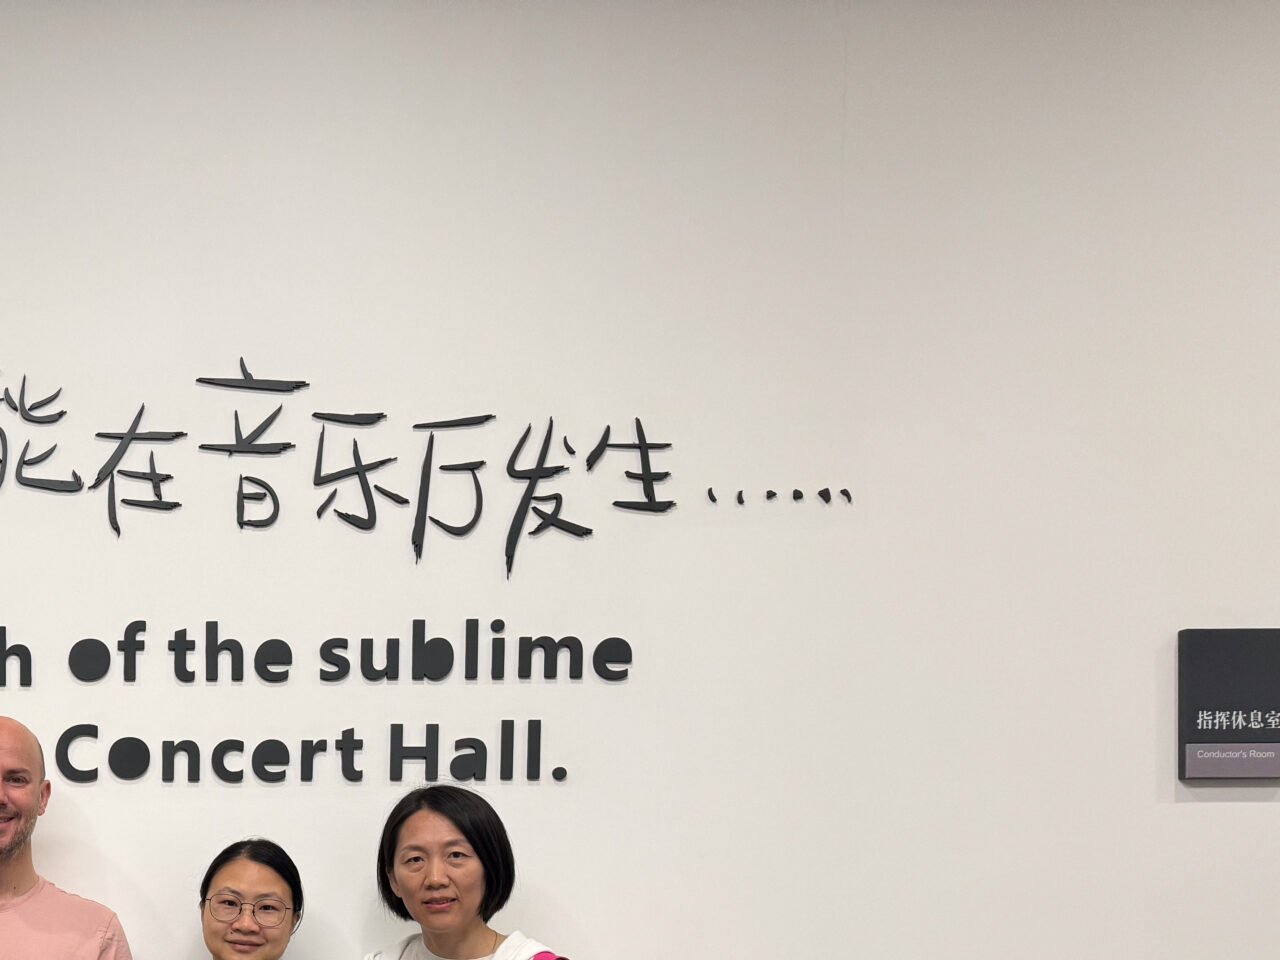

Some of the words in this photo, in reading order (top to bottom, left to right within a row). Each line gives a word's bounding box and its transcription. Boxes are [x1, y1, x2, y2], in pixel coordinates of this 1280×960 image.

[68, 620, 147, 684] of
[167, 621, 293, 684] the
[319, 618, 633, 683] sublime
[1196, 709, 1280, 730] 指挥休息室
[55, 723, 364, 784] Concert
[389, 719, 568, 783] Hall.
[1196, 749, 1247, 759] Conductor's
[1249, 749, 1275, 759] Room
